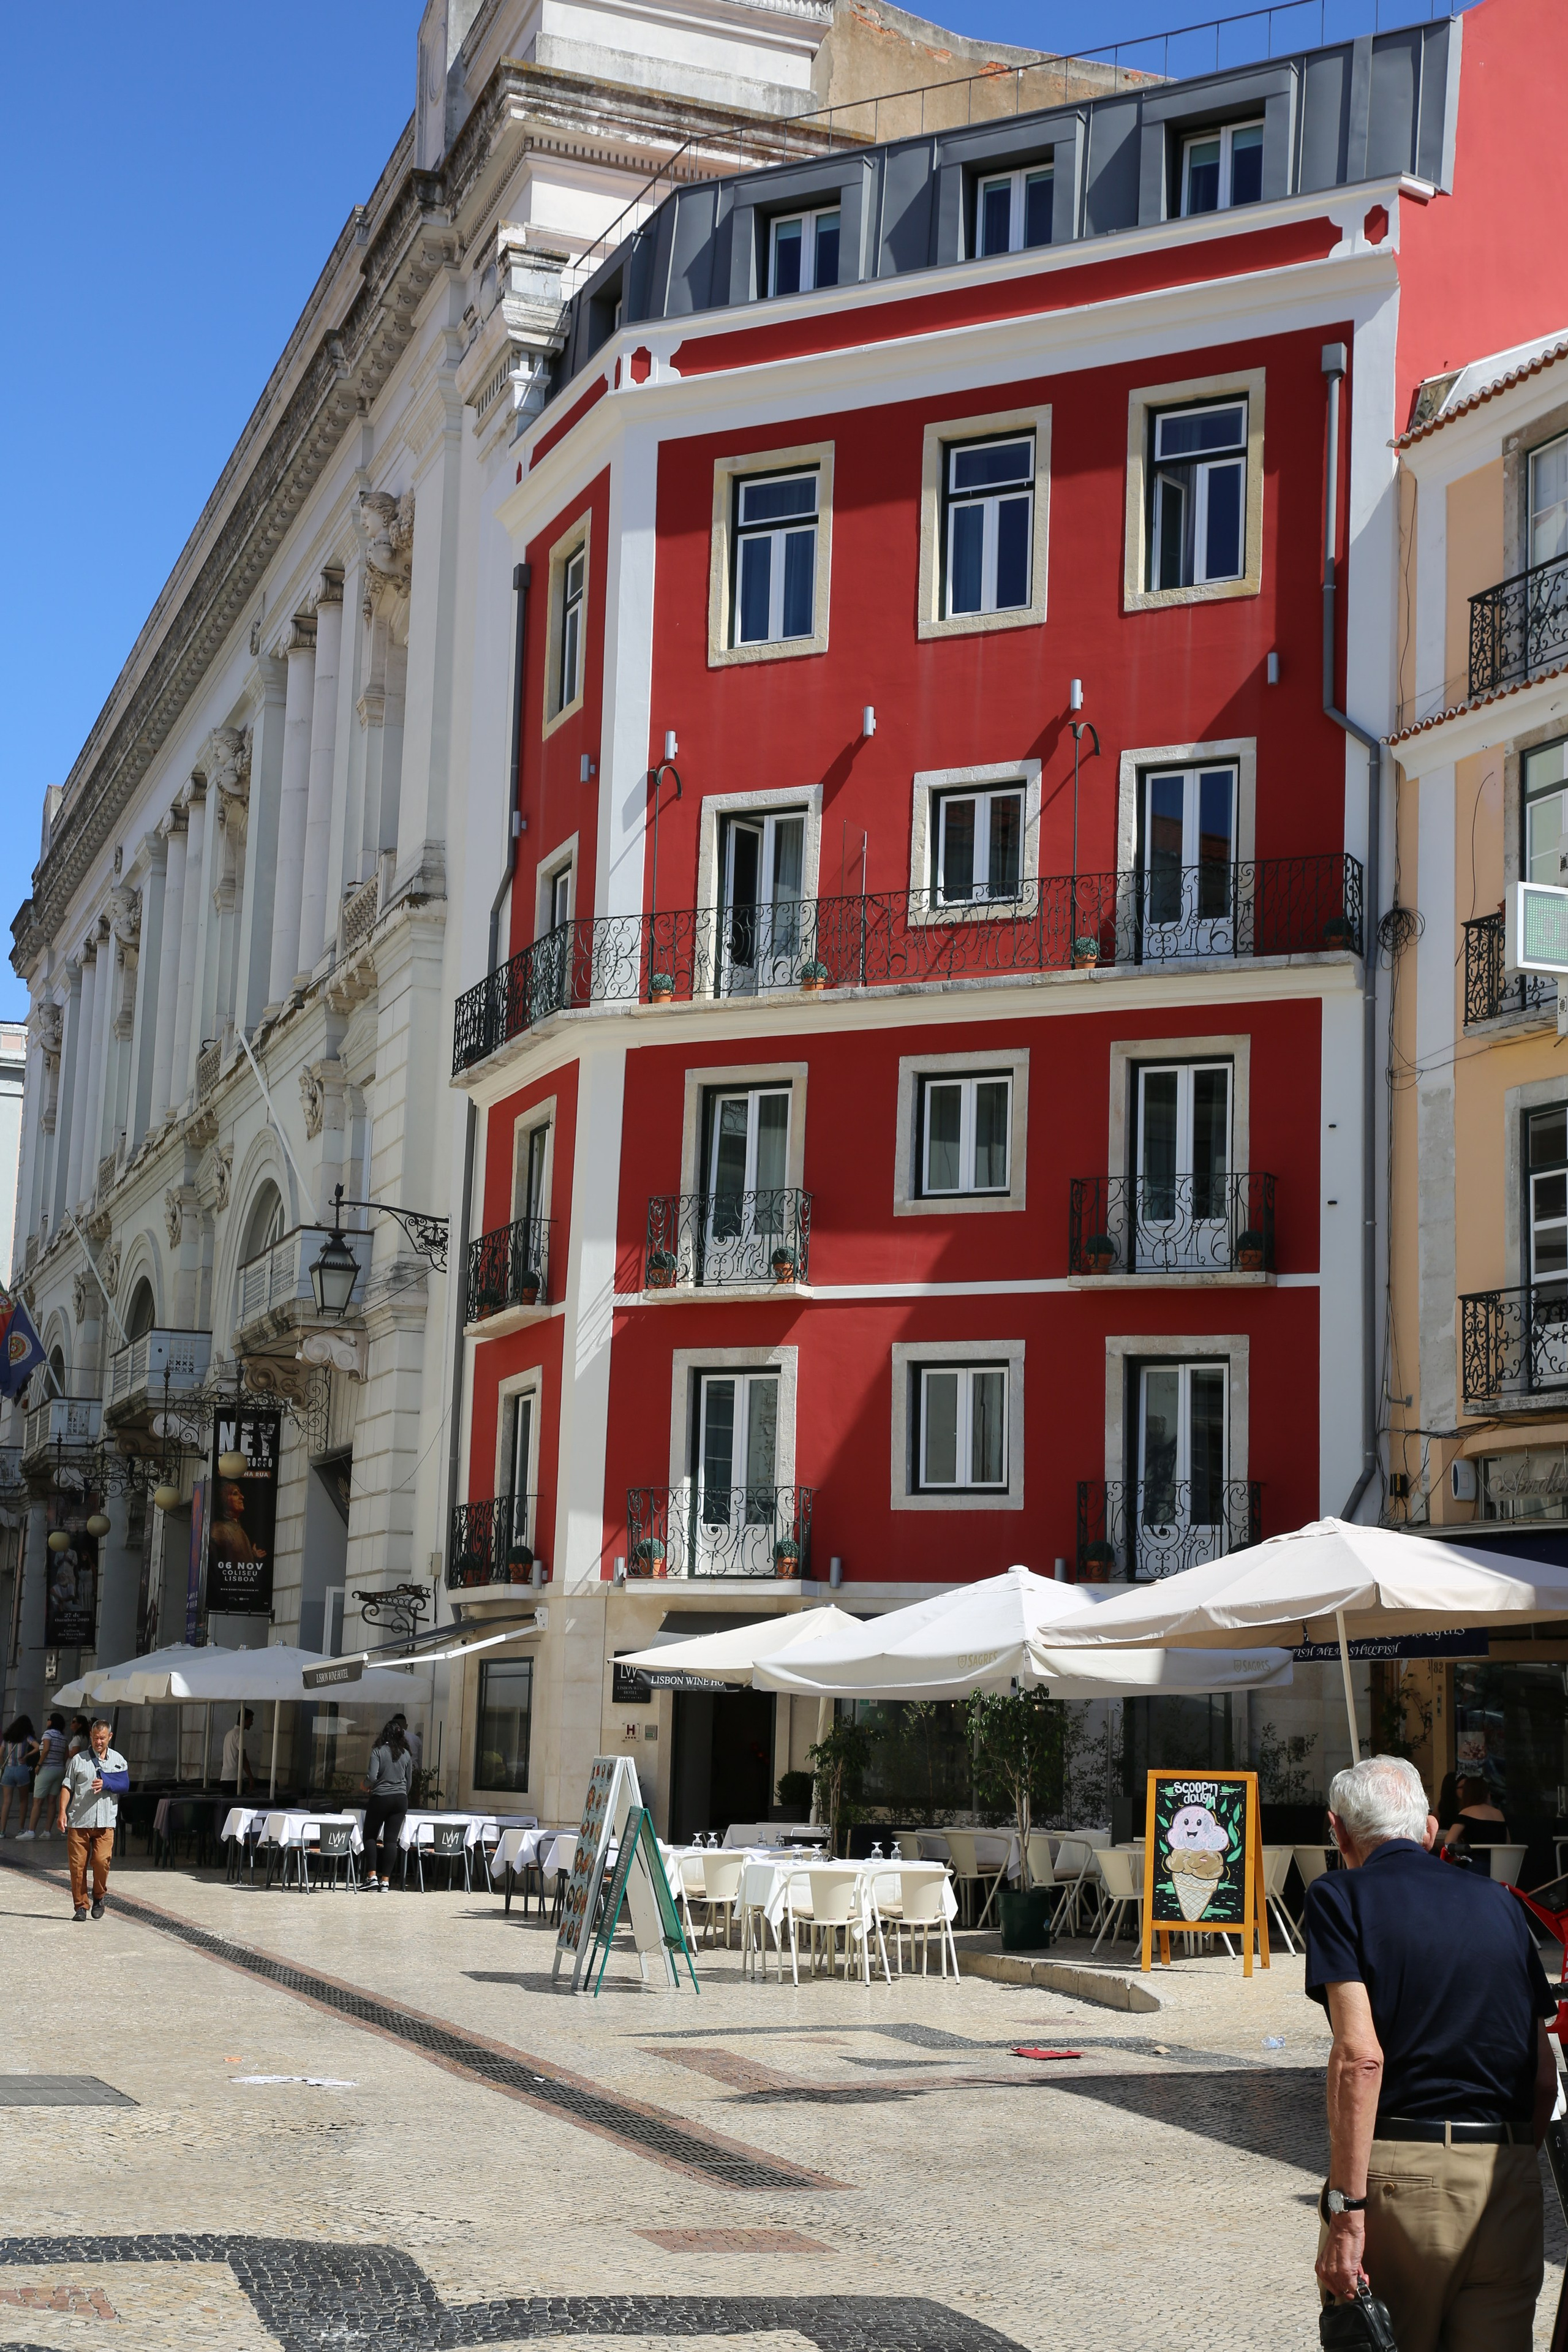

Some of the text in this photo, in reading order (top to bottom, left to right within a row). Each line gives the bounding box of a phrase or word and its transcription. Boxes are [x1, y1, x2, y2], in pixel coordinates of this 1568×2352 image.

[219, 1421, 275, 1457] NEY
[1317, 1646, 1341, 1656] MEA
[968, 1651, 998, 1668] SAGRES
[1243, 1659, 1271, 1673] SAGRES
[1433, 1661, 1444, 1673] 82
[316, 1673, 328, 1683] LISBON
[337, 1668, 349, 1679] HOTEL
[650, 1675, 684, 1685] LISBON
[685, 1676, 709, 1686] WINE
[627, 1724, 635, 1735] H
